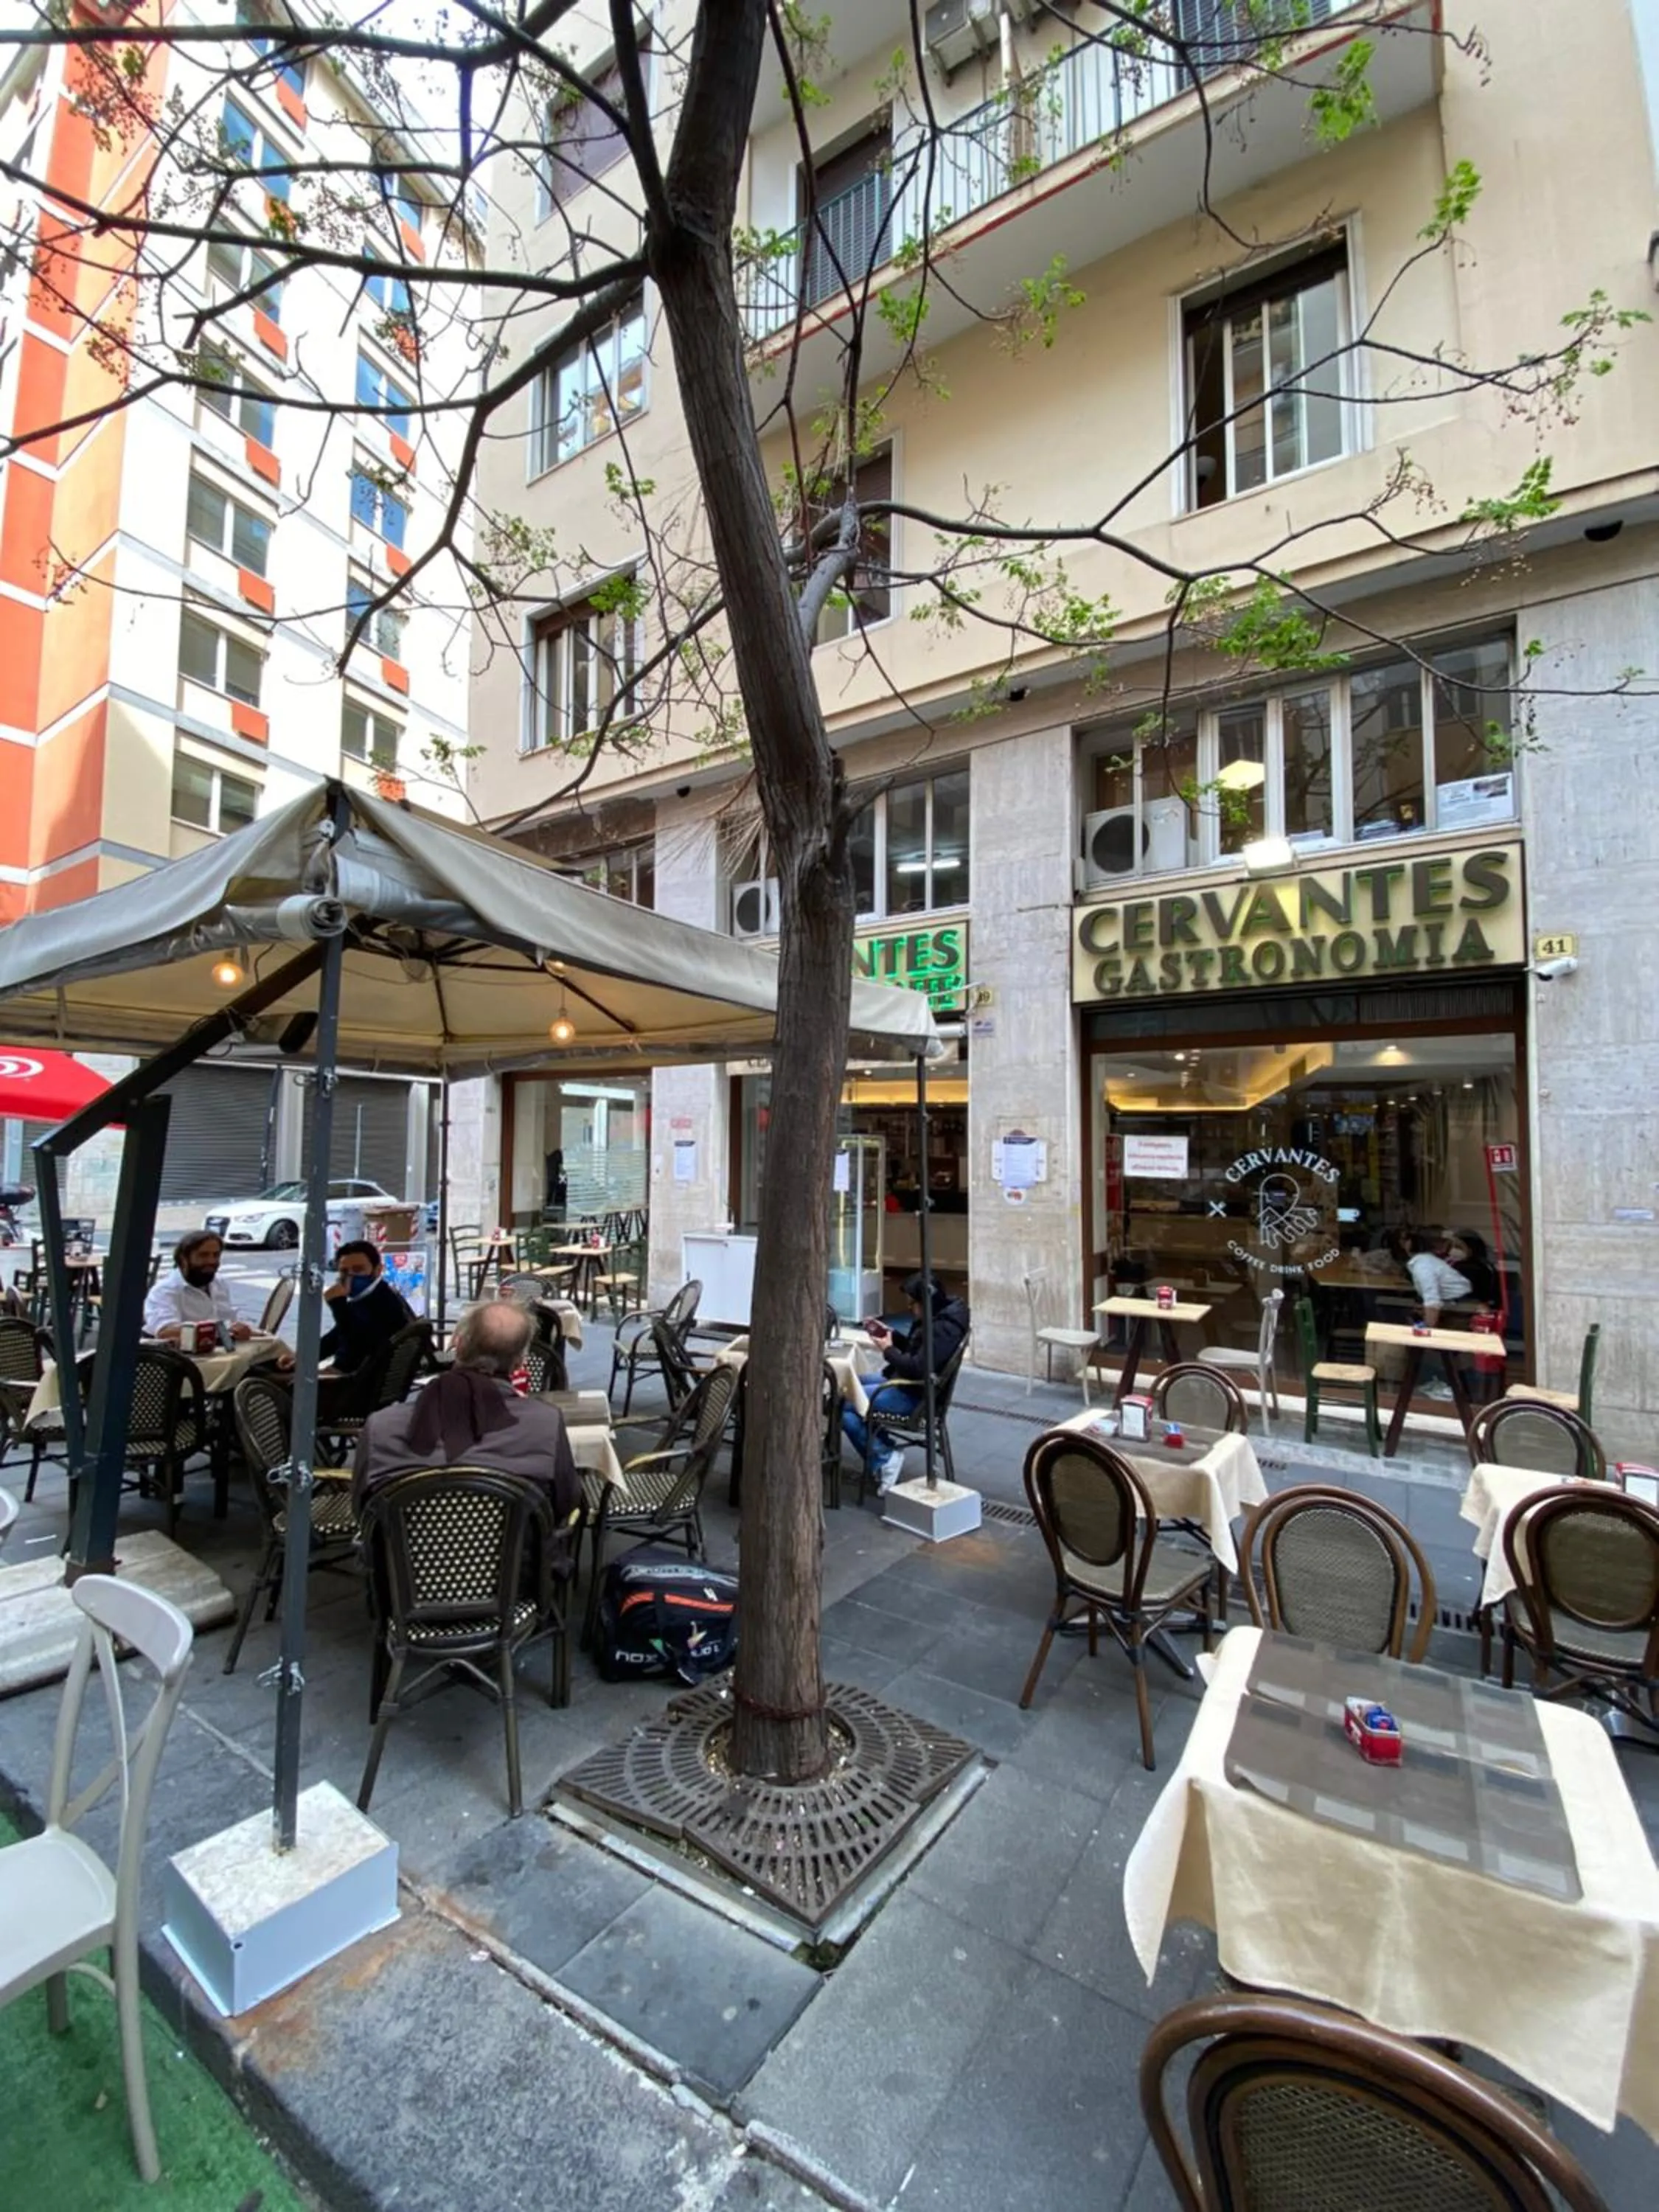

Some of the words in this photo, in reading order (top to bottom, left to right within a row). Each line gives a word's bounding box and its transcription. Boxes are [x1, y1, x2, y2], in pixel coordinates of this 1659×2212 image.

[1079, 851, 1512, 956] CERVANTES
[852, 929, 961, 978] NTES
[1093, 919, 1496, 997] GASTRONOMIA
[1542, 938, 1567, 955] 41
[1225, 1147, 1341, 1183] CERVANTES
[1227, 1239, 1266, 1270] COFFEE
[1270, 1264, 1305, 1274] DRINK
[1307, 1248, 1340, 1271] FOOD
